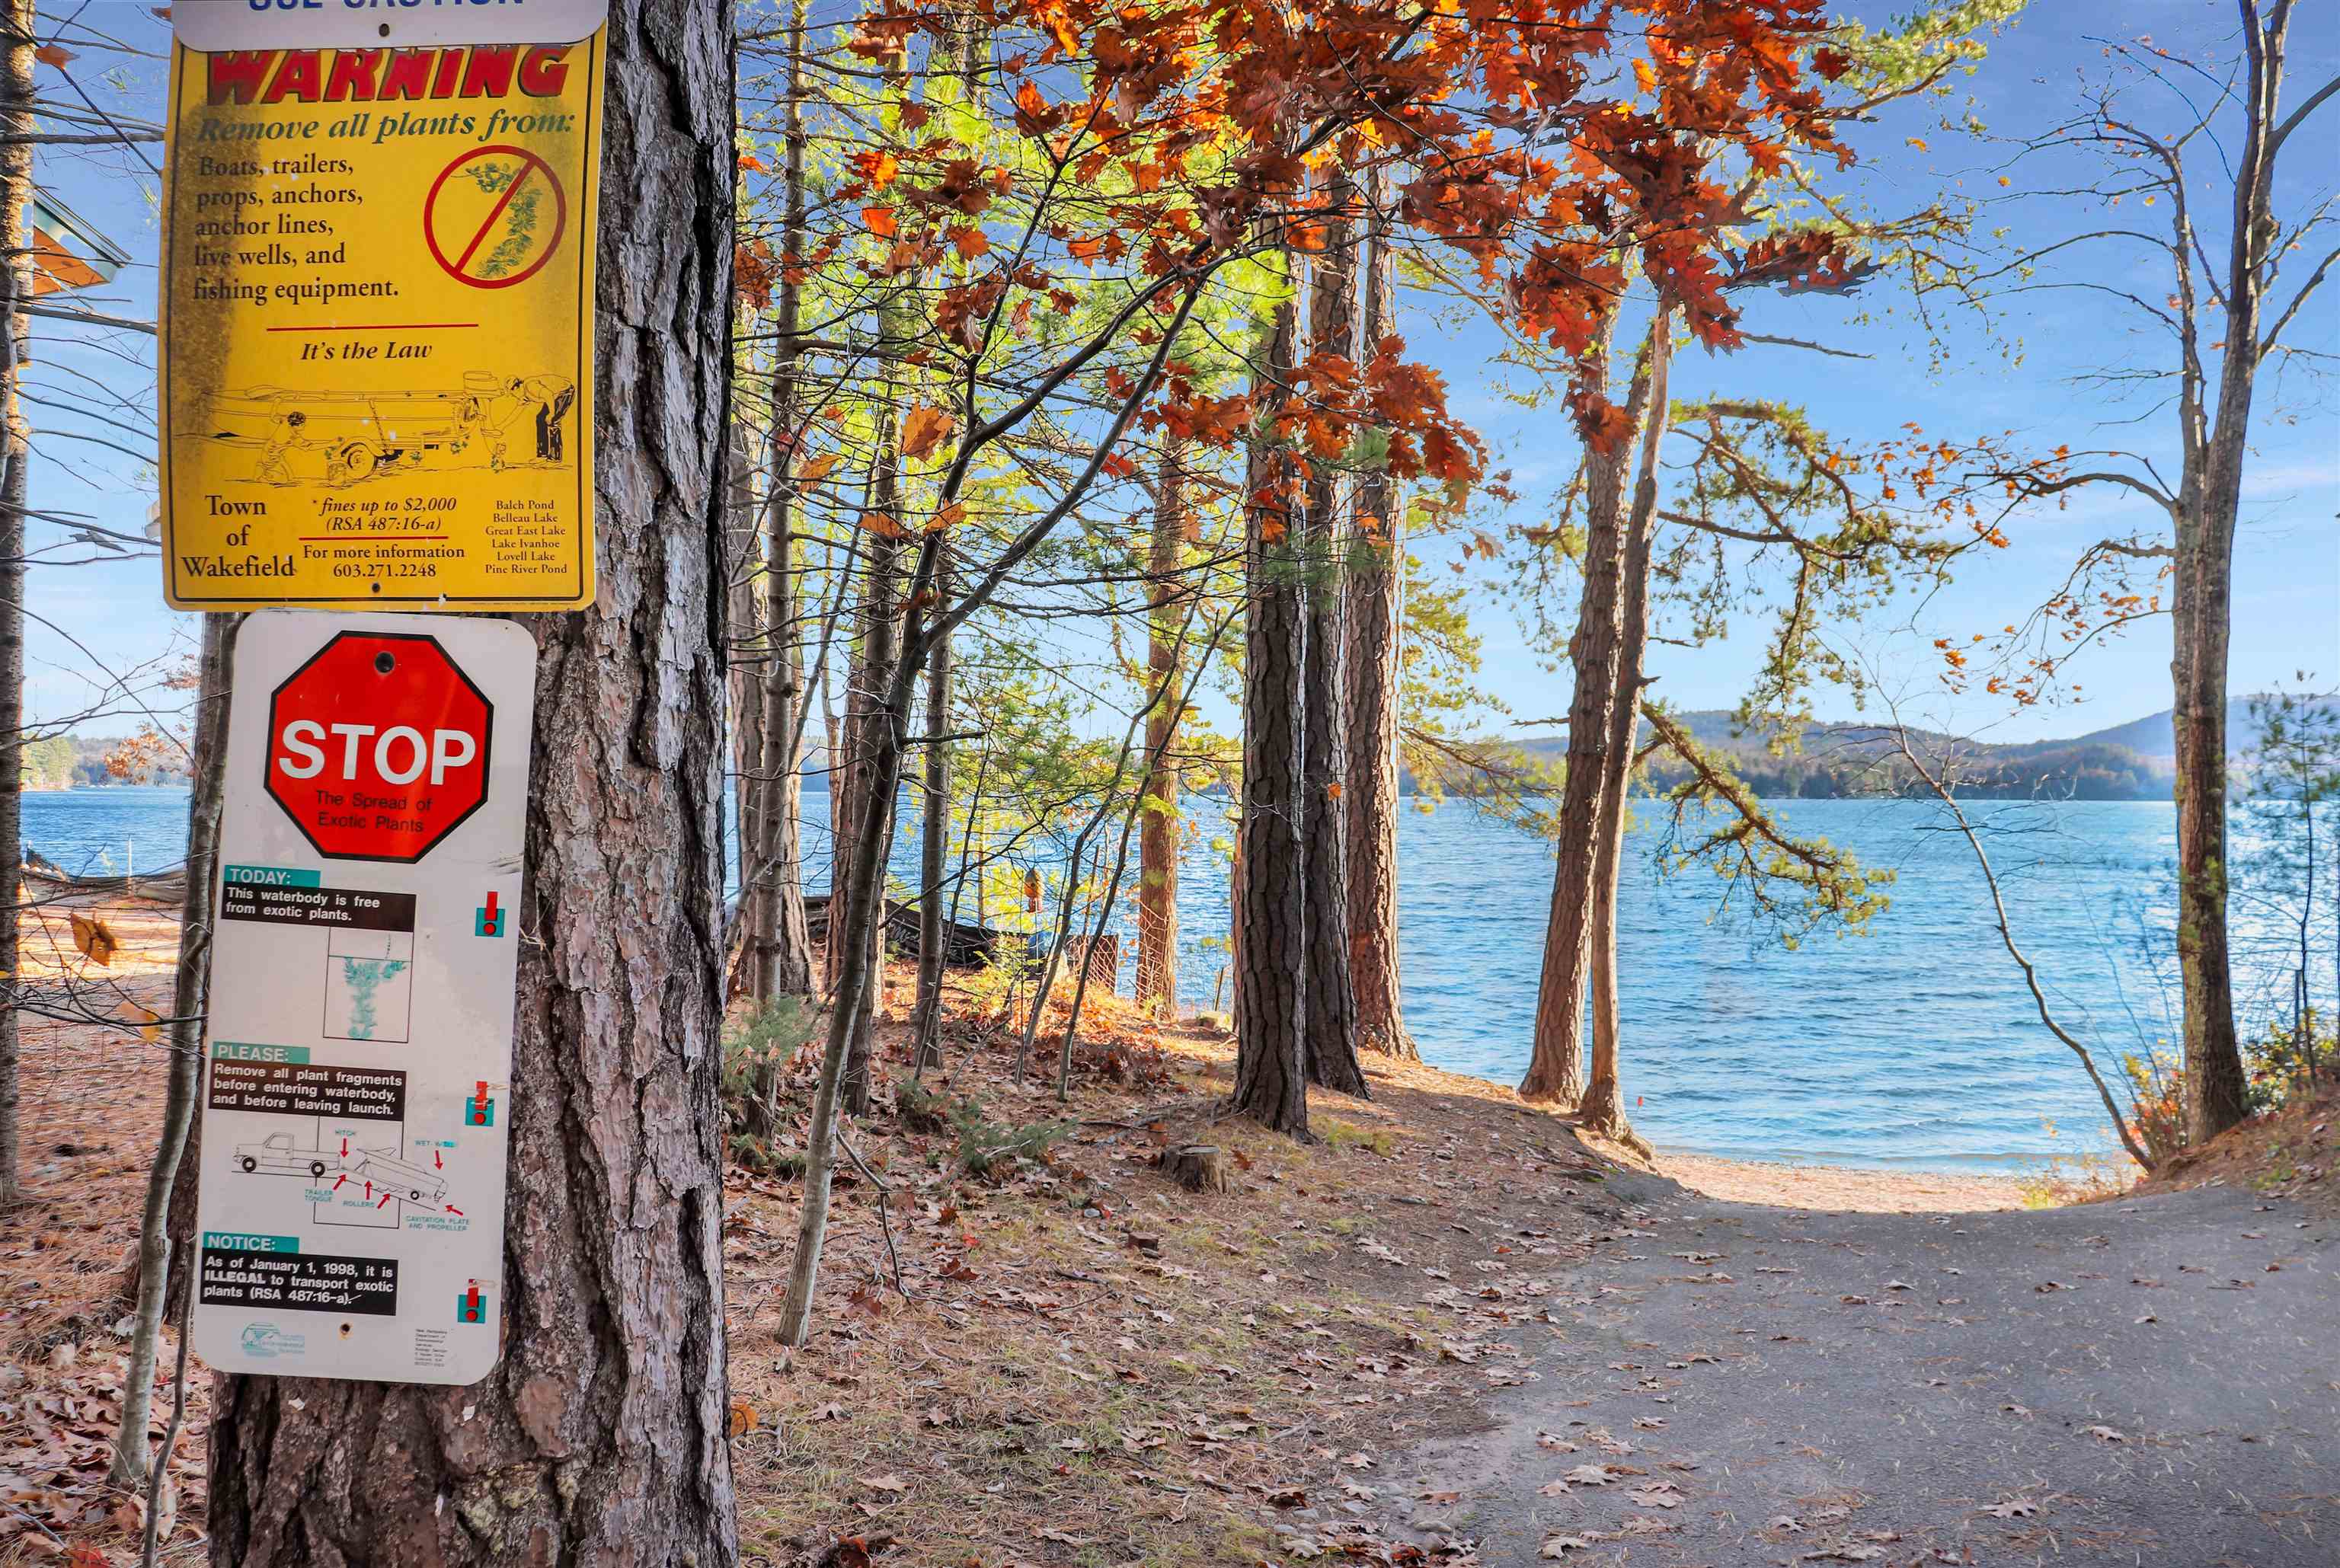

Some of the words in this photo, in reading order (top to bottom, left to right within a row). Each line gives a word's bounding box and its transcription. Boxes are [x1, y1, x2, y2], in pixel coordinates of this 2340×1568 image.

[207, 43, 573, 105] WARNING
[198, 118, 319, 142] Remove
[328, 112, 370, 138] all
[372, 112, 476, 144] plants
[478, 108, 575, 142] from:
[199, 156, 264, 177] Boats,
[273, 153, 353, 176] trailers,
[196, 190, 264, 212] props,
[272, 182, 363, 205] anchors,
[195, 214, 270, 236] anchor
[277, 213, 334, 236] lines,
[194, 244, 231, 267] live
[238, 243, 298, 267] wells,
[305, 241, 346, 264] and
[193, 277, 268, 306] fishing
[274, 276, 399, 305] equipment.
[300, 341, 335, 360] It's
[342, 341, 379, 359] the
[384, 341, 433, 359] Law
[204, 494, 267, 516] Town
[318, 497, 356, 516] fines
[361, 500, 379, 516] up
[384, 500, 398, 512] to
[403, 497, 457, 513] $2,000
[496, 500, 525, 510] Balch
[528, 500, 555, 509] Pond
[326, 516, 363, 532] (RSA
[368, 516, 442, 533] 487:16-a)
[493, 513, 530, 522] Belleau
[534, 513, 558, 522] Lake
[225, 523, 251, 547] of
[485, 525, 513, 535] Great
[517, 525, 538, 535] East
[542, 525, 566, 535] Lake
[303, 544, 328, 559] For
[334, 548, 371, 558] more
[376, 543, 465, 558] information
[491, 538, 516, 548] Lake
[519, 538, 561, 548] Ivanhoe
[180, 554, 295, 577] Wakefield
[497, 551, 527, 561] Lovell
[531, 551, 555, 561] Lake
[333, 563, 436, 579] 603.271.2248
[485, 564, 508, 573] Pine
[511, 564, 538, 573] River
[542, 564, 567, 573] Pond
[278, 719, 477, 786] STOP
[316, 789, 344, 806] The
[352, 791, 408, 810] Spread
[416, 797, 433, 811] of
[318, 811, 366, 829] Exotic
[376, 815, 424, 833] Plants
[229, 868, 291, 885] TODAY:
[227, 886, 254, 900] This
[261, 890, 328, 906] waterbody
[335, 893, 347, 906] is
[353, 894, 381, 909] free
[225, 902, 256, 915] from
[263, 904, 302, 918] exotic
[308, 908, 352, 921] plants.
[217, 1044, 289, 1062] PLEASE:
[214, 1062, 266, 1078] Remove
[273, 1068, 289, 1079] all
[296, 1069, 329, 1082] plant
[336, 1071, 402, 1087] fragments
[213, 1078, 257, 1091] before
[264, 1082, 318, 1098] entering
[325, 1087, 396, 1103] waterbody,
[212, 1094, 237, 1105] and
[244, 1094, 287, 1109] before
[294, 1097, 341, 1114] leaving
[348, 1101, 394, 1116] launch.
[207, 1234, 276, 1251] NOTICE:
[205, 1256, 223, 1268] As
[230, 1257, 244, 1269] of
[249, 1258, 300, 1273] January
[307, 1262, 317, 1275] 1,
[323, 1263, 359, 1278] 1998,
[366, 1265, 376, 1277] it
[382, 1266, 394, 1278] is
[204, 1269, 267, 1285] ILLEGAL
[270, 1274, 284, 1285] to
[290, 1275, 349, 1290] transport
[355, 1279, 395, 1293] exotic
[203, 1285, 244, 1298] plants
[250, 1286, 282, 1300] (RSA
[288, 1290, 353, 1305] 487:16-a).
